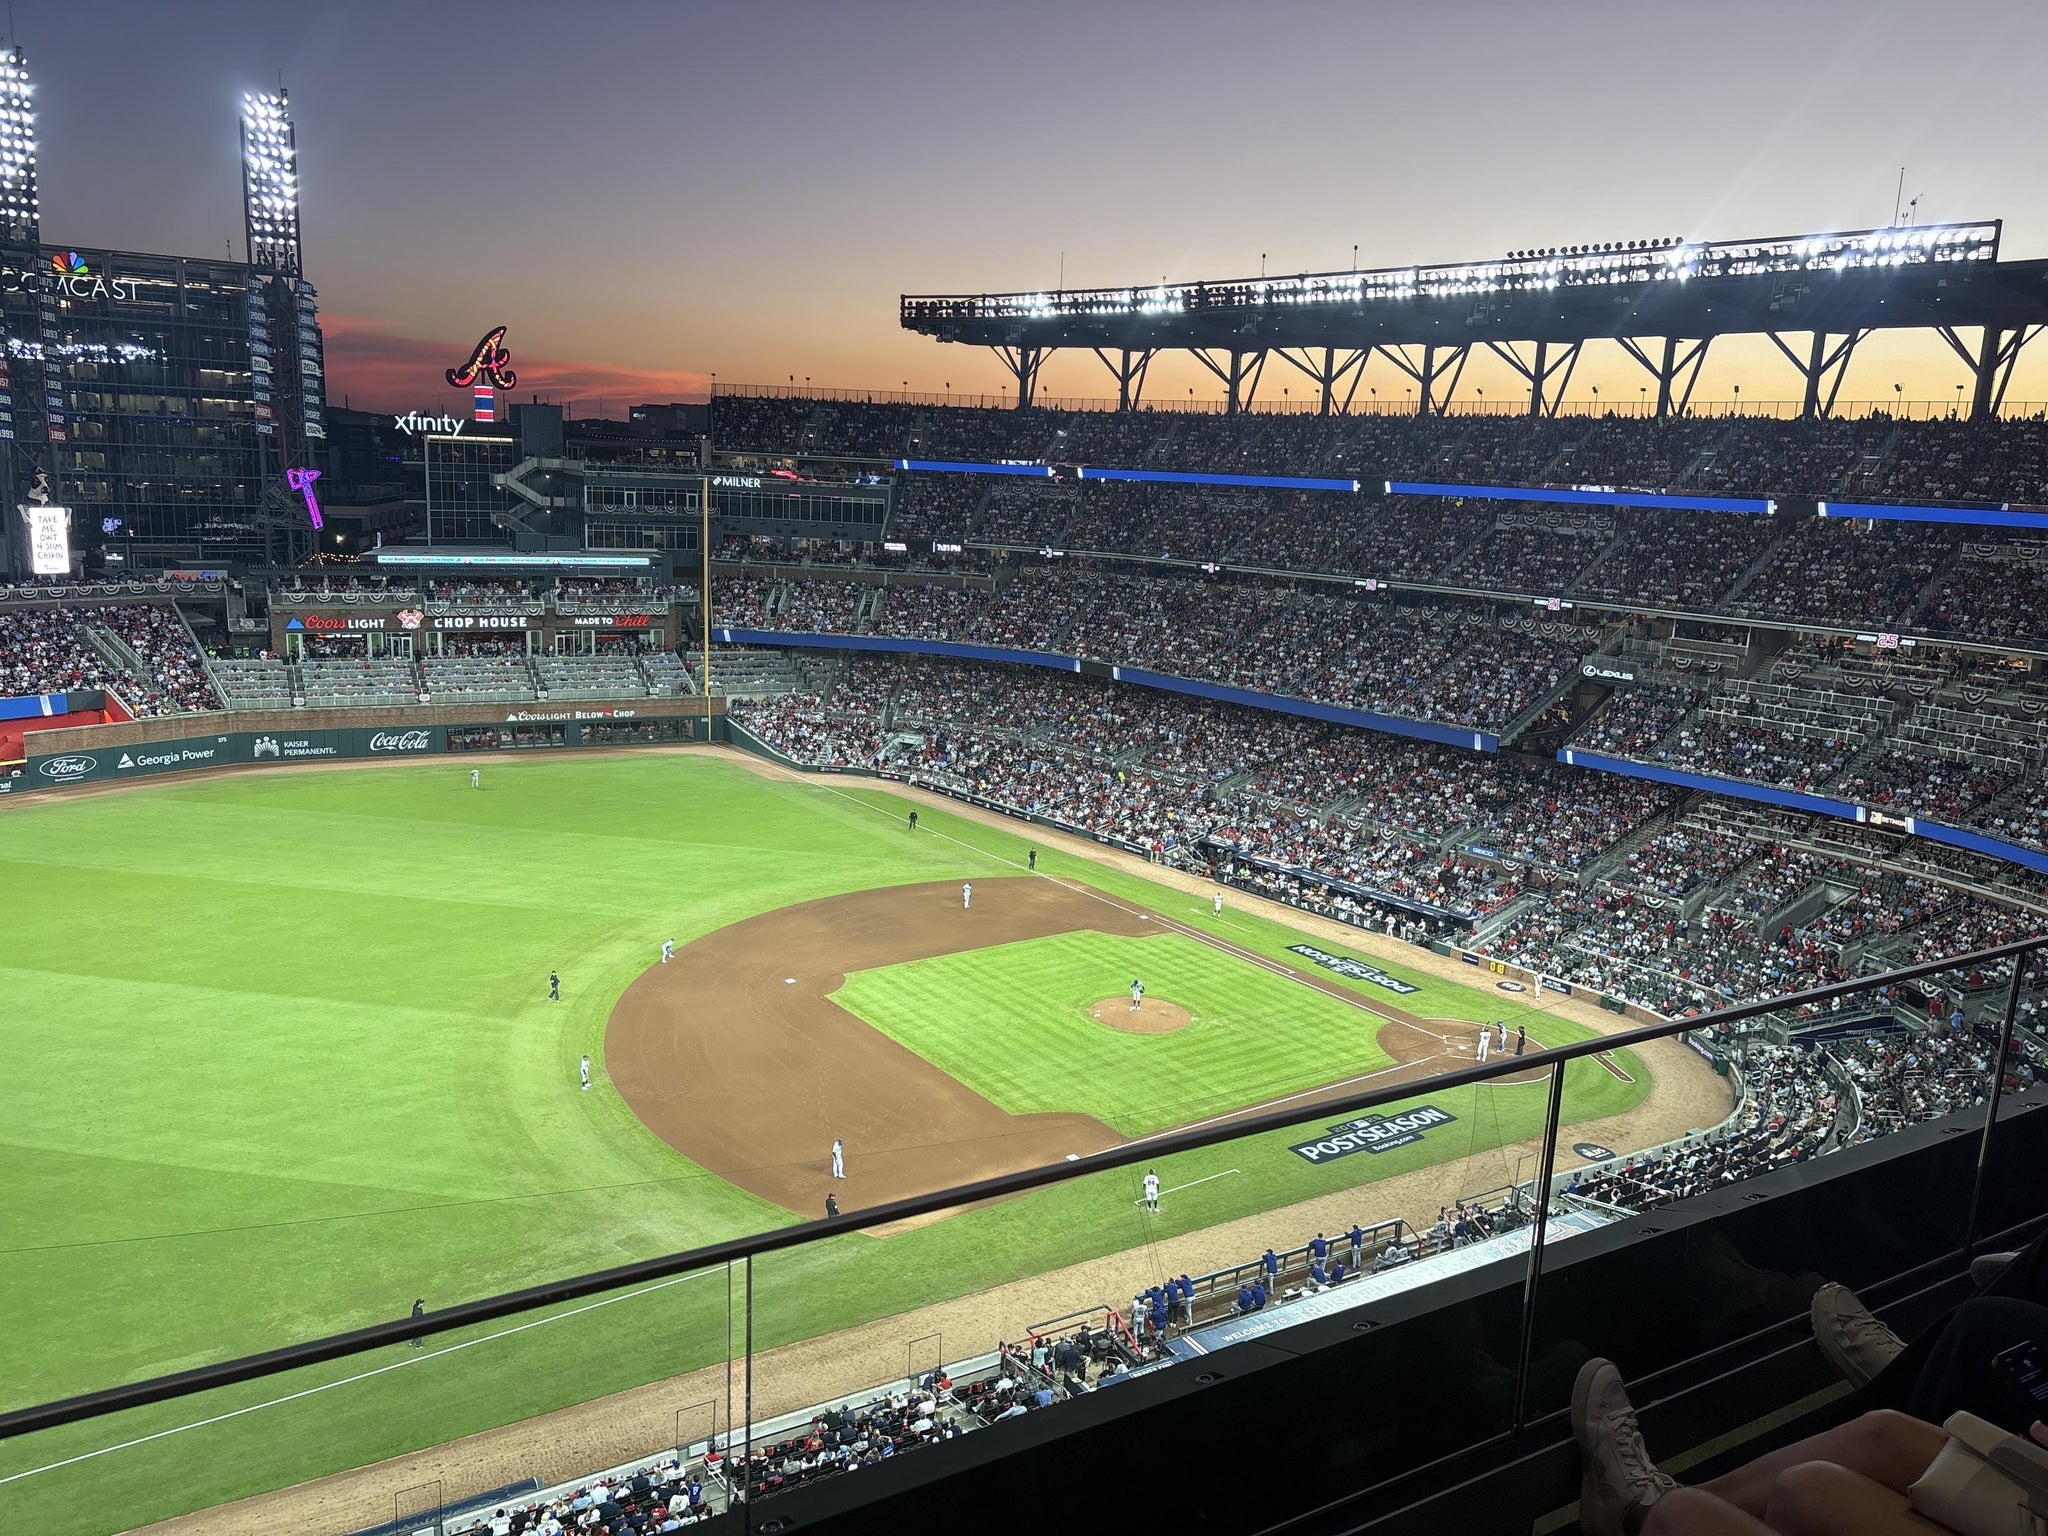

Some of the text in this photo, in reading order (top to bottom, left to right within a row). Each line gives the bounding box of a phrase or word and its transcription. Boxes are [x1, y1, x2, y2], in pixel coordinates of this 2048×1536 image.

[254, 359, 269, 370] 2010
[303, 362, 317, 373] 2012
[255, 375, 270, 386] 2013
[304, 378, 319, 389] 2018
[255, 391, 270, 402] 2019
[304, 394, 319, 405] 2020
[256, 407, 271, 418] 2021
[306, 410, 320, 420] 2022
[49, 413, 65, 424] 1992
[394, 411, 465, 437] xfinity
[257, 424, 272, 434] 2023
[50, 430, 66, 440] 1995
[722, 476, 761, 489] MILNER
[38, 515, 57, 524] TAKE
[37, 542, 43, 550] 4
[37, 551, 64, 560] CHIKIN
[304, 614, 386, 630] Coors LIGHT
[434, 617, 527, 628] CHOP HOUSE
[574, 614, 651, 627] MADE TO Chill
[1877, 633, 1899, 648] 25
[1597, 668, 1634, 680] LEXUS
[518, 710, 545, 721] Coors
[575, 711, 603, 719] BELOW
[613, 709, 635, 718] CHOP
[284, 740, 309, 748] KAISER
[370, 730, 432, 751] Coca-Cola
[137, 749, 215, 766] Georgia Power
[50, 758, 87, 775] Ford
[1472, 847, 1494, 857] GEICO
[1292, 945, 1415, 992] POSTSEASON
[1688, 1036, 1714, 1061] Booking.com
[1298, 1108, 1448, 1160] POSTSEASON
[1221, 1320, 1271, 1343] WELCOME
